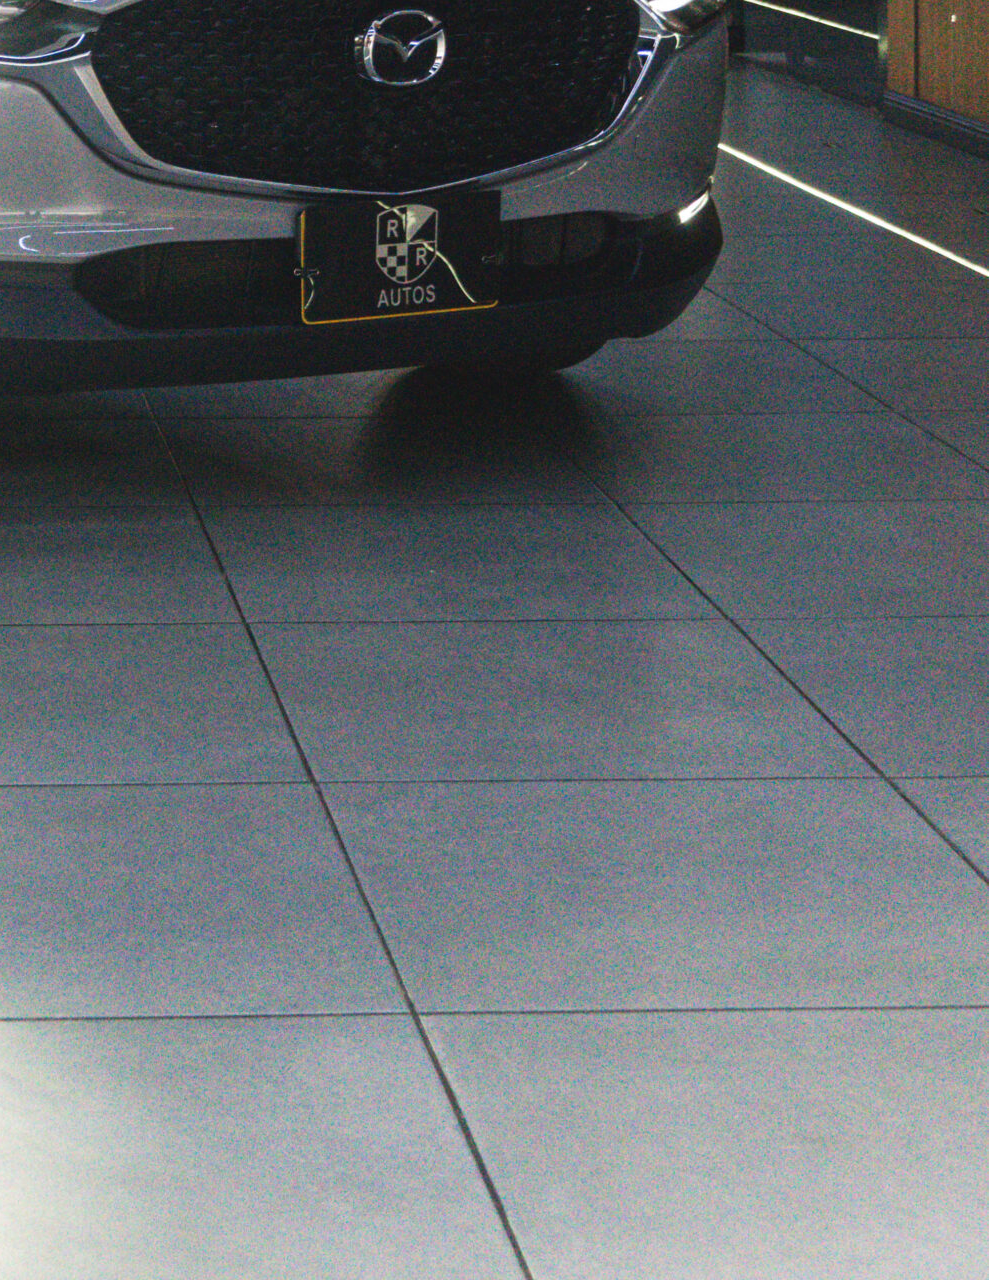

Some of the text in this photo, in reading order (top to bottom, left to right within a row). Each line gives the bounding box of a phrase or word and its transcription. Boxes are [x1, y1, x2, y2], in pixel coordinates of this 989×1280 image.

[387, 219, 399, 238] R
[416, 248, 428, 266] R
[377, 285, 436, 308] AUTOS
